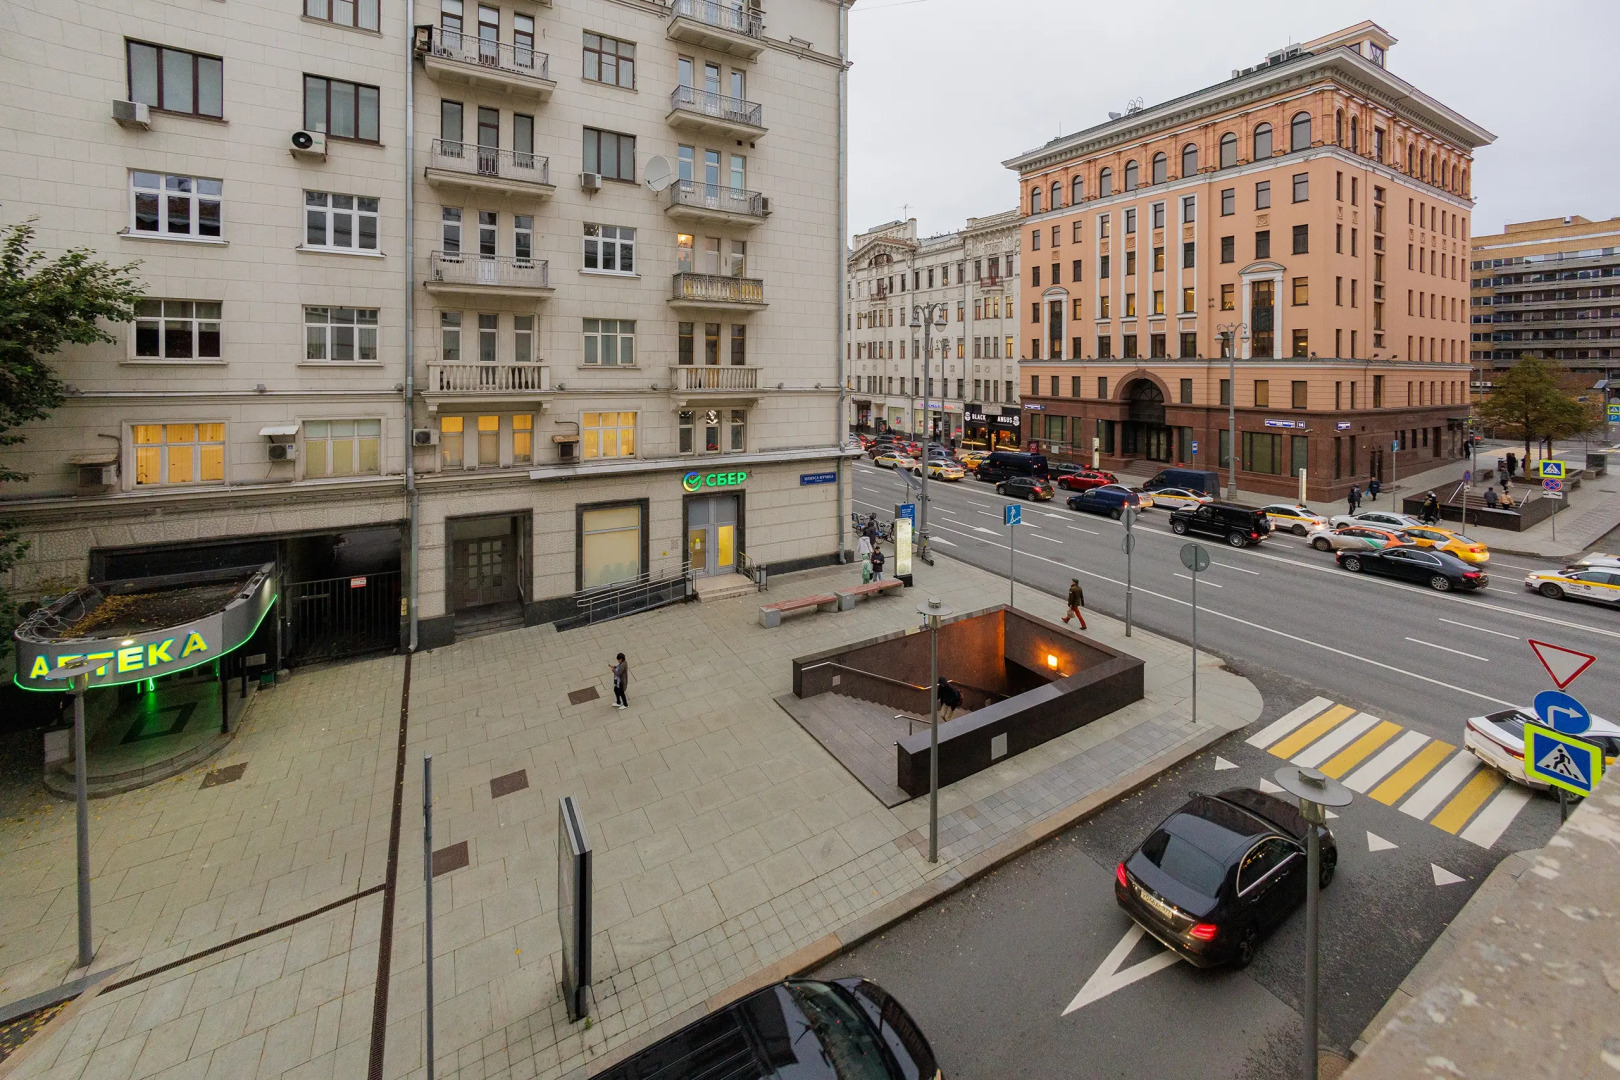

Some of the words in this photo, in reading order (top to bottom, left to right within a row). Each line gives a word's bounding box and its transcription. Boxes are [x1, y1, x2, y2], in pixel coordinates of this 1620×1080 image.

[971, 413, 986, 421] BLACK
[997, 415, 1013, 424] ANGUS
[705, 471, 748, 487] СБЕР
